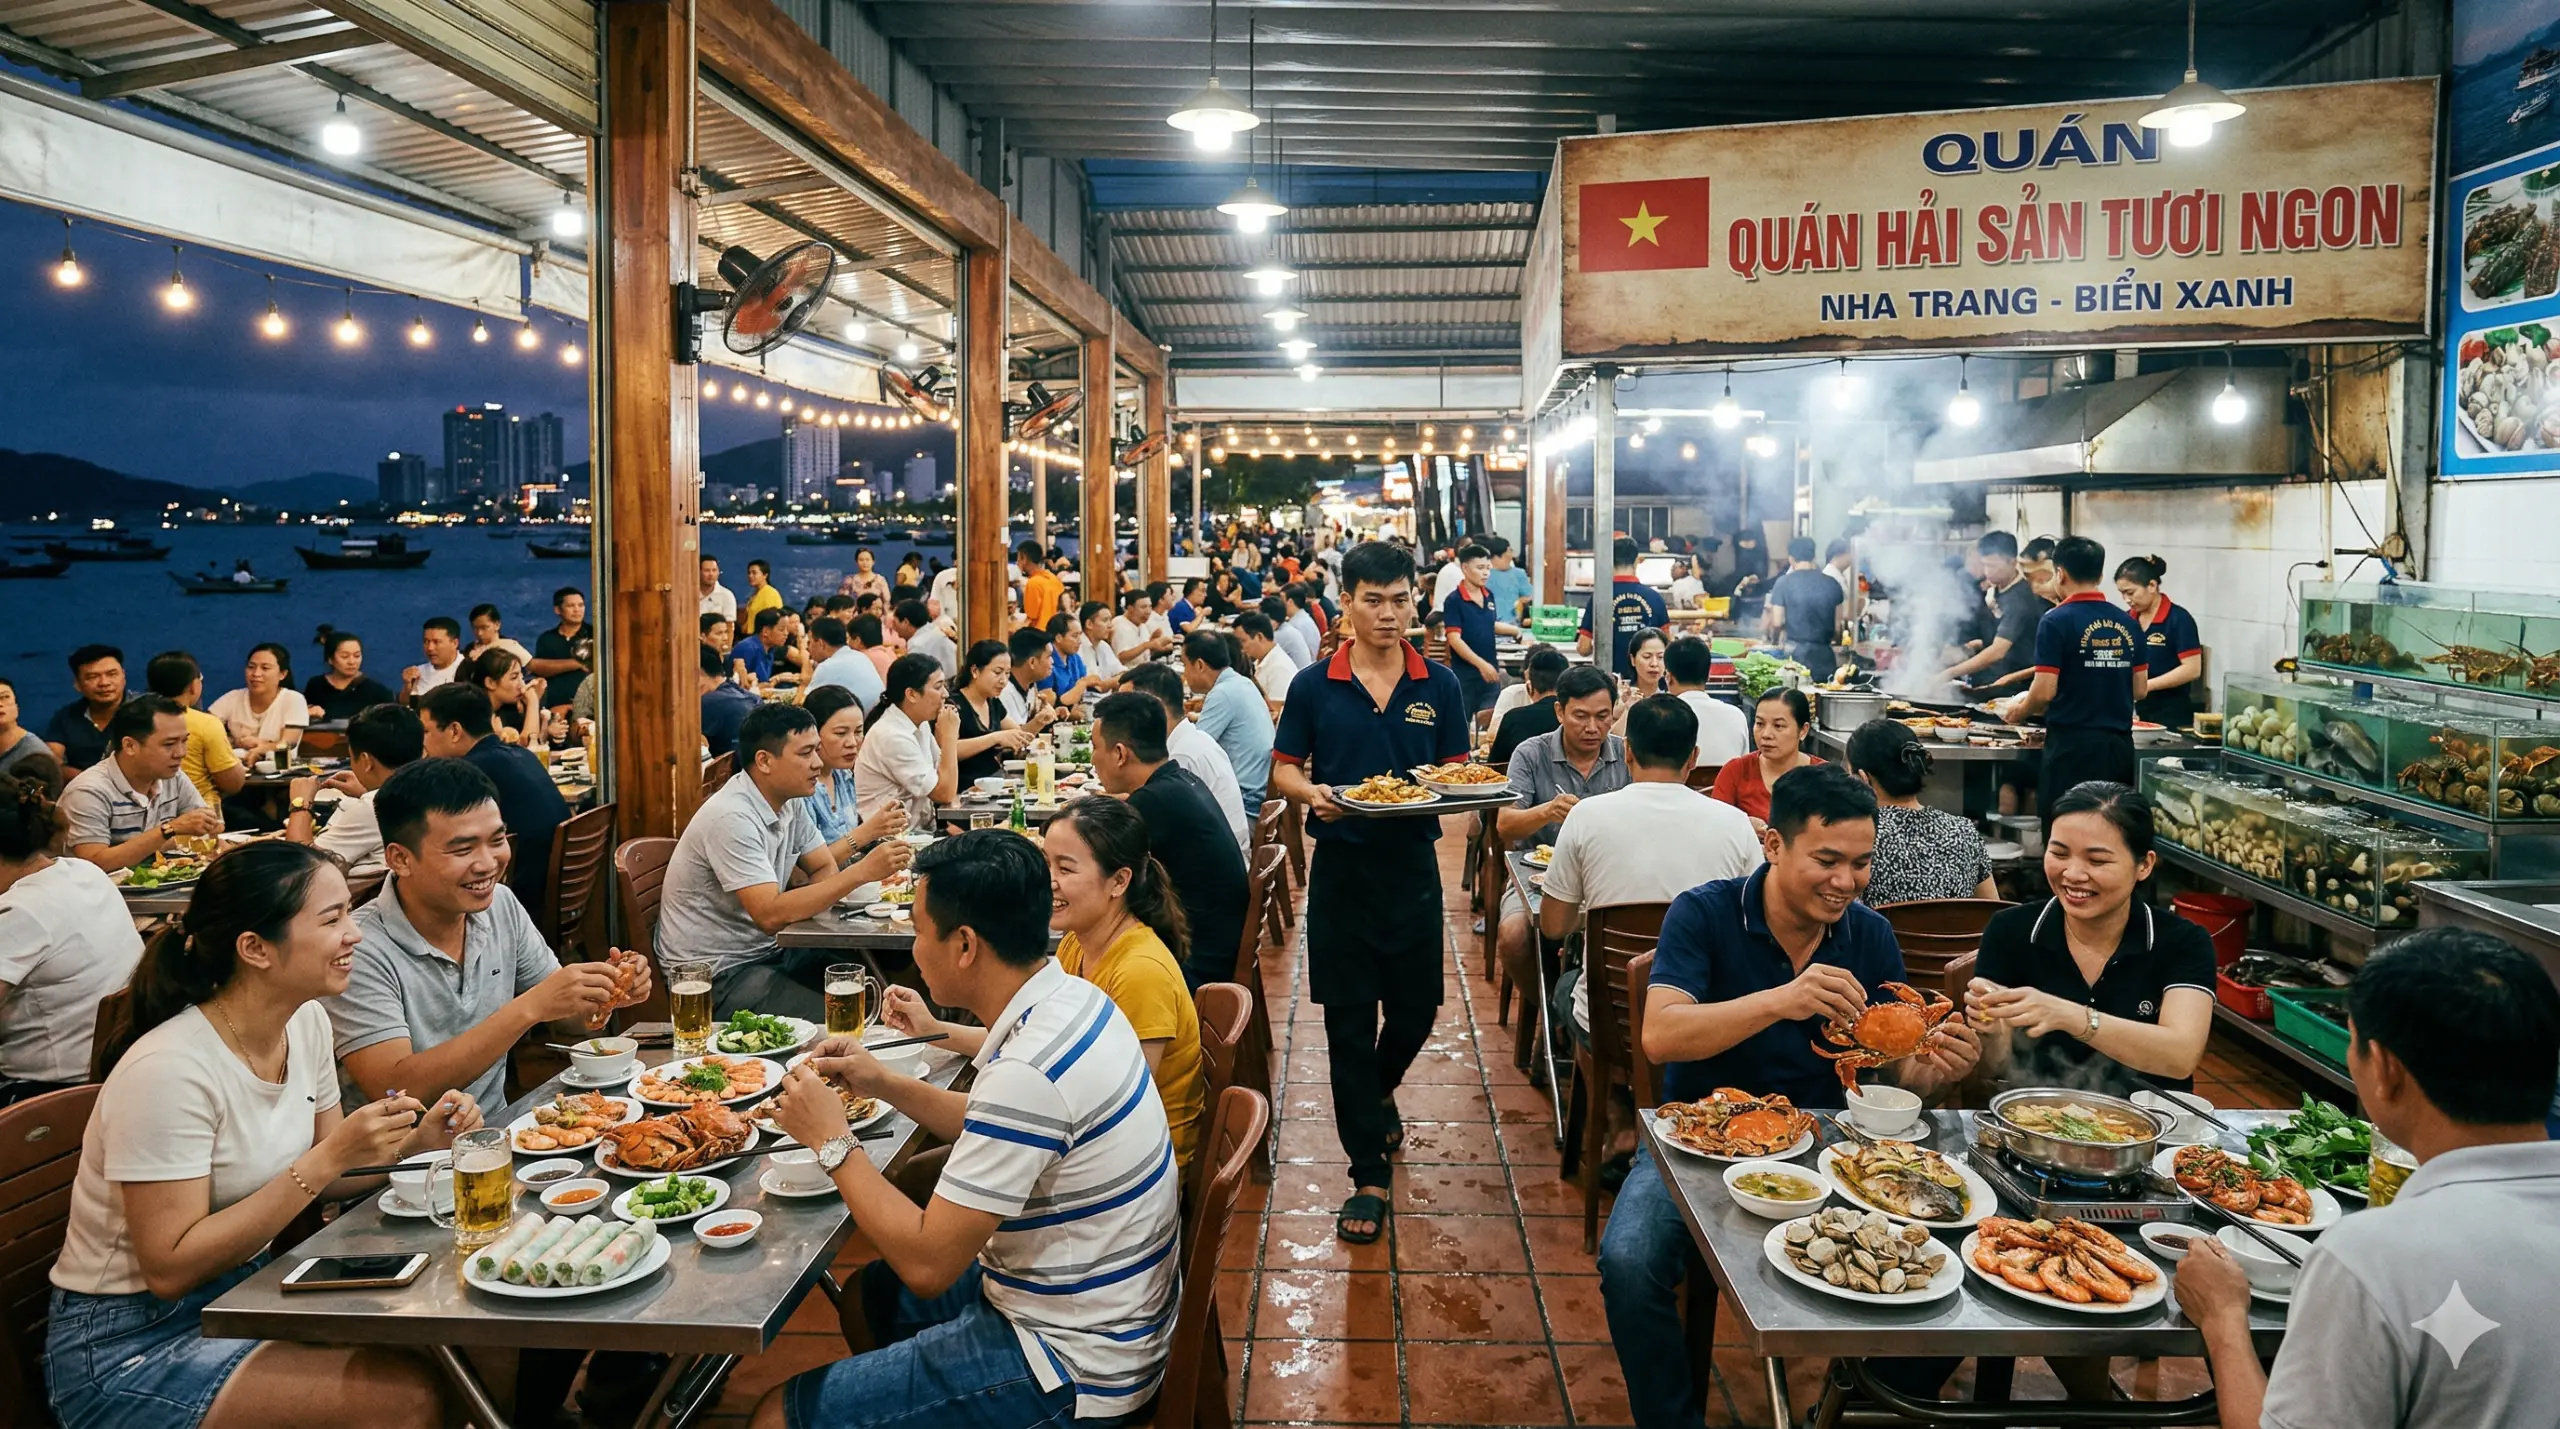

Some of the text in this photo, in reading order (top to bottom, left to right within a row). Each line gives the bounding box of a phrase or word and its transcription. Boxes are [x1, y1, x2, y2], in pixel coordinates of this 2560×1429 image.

[1922, 113, 2158, 174] QUÁN
[1728, 182, 2399, 281] QUÁN HẢI SẢN TƯƠI NGON
[1820, 293, 1897, 321] NHA
[1908, 287, 2038, 318] TRANG
[2074, 268, 2163, 313] BIỂN
[2176, 277, 2294, 309] XANH
